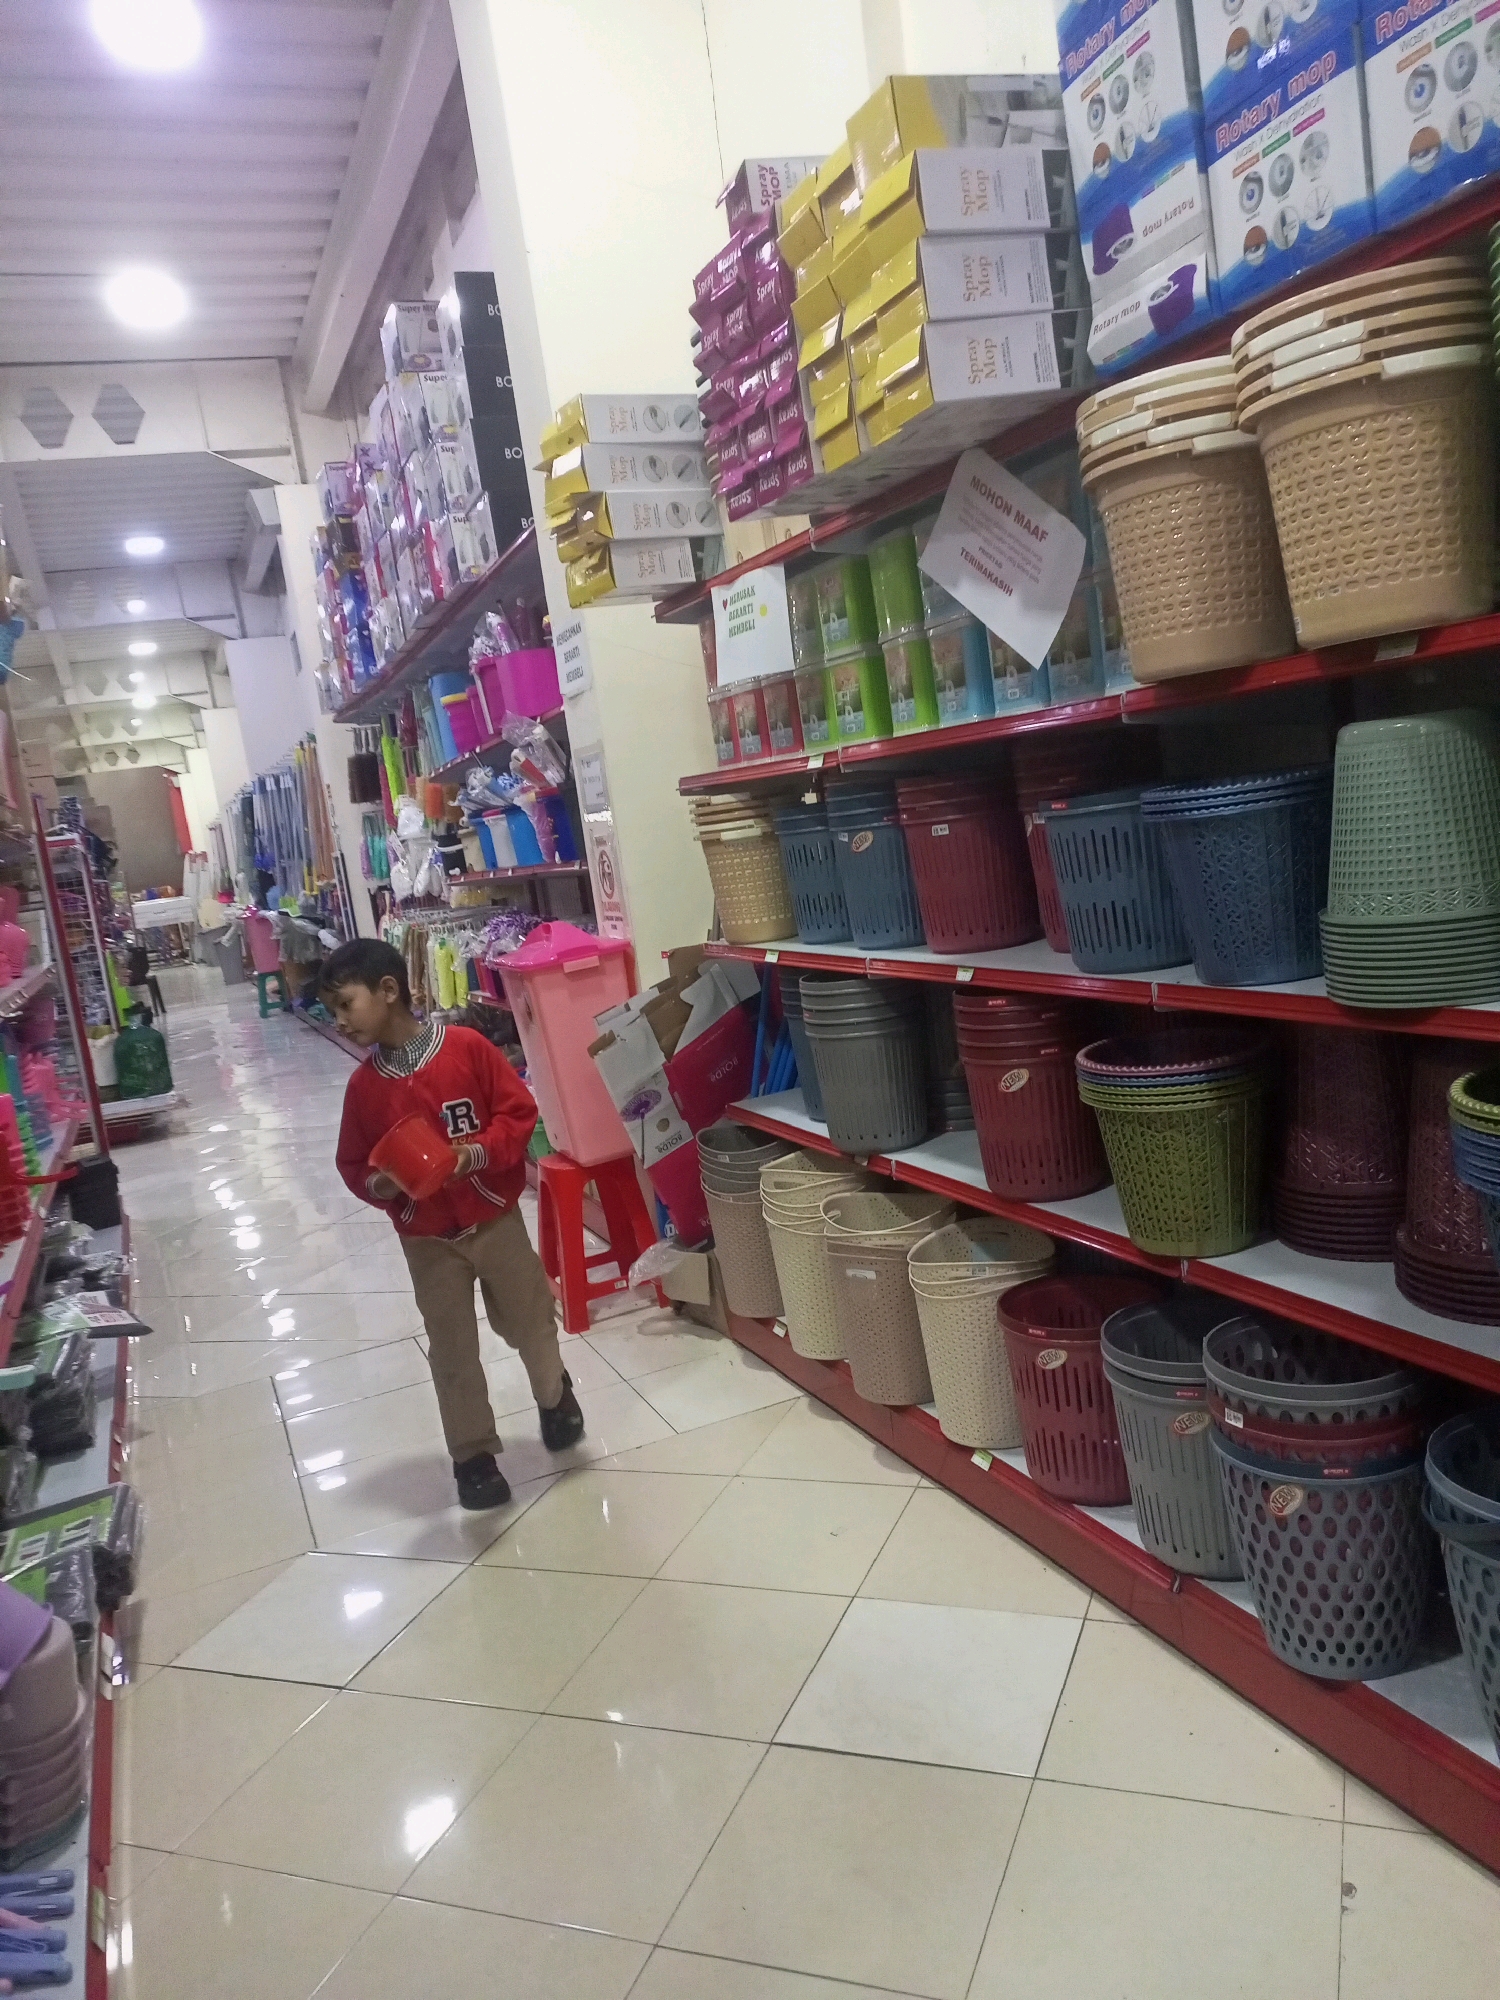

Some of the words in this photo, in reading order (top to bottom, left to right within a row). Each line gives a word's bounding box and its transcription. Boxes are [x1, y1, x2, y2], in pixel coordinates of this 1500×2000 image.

[1375, 0, 1454, 45] Rota
[1066, 16, 1116, 80] Rotary
[1216, 87, 1282, 153] Rotary
[1287, 50, 1337, 101] mop
[757, 164, 772, 207] Spray
[960, 166, 974, 217] Spray
[976, 169, 990, 214] Mop
[1164, 196, 1195, 227] Rotary
[1142, 219, 1163, 238] mop
[963, 253, 979, 302] Spray
[979, 255, 993, 298] Mop
[756, 277, 777, 305] Spray
[726, 303, 744, 328] Spray
[1093, 312, 1120, 336] Rotary
[1120, 300, 1141, 319] mop
[968, 336, 981, 386] Spray
[984, 338, 998, 379] Mop
[608, 404, 619, 434] Spray
[619, 406, 629, 433] Mop
[778, 402, 798, 425] Spray
[747, 425, 767, 446] Spray
[721, 443, 738, 463] Spray
[787, 455, 808, 477] Spray
[609, 454, 621, 484] Spray
[619, 456, 629, 482] Mop
[759, 473, 780, 493] Spray
[730, 488, 752, 510] Spray
[969, 474, 1013, 517] MOHON
[1013, 509, 1049, 543] MAAF
[633, 502, 643, 531] Spray
[643, 503, 652, 529] Mop
[959, 546, 1014, 597] TERIMAKASIH
[728, 585, 756, 607] MERUSAK
[728, 603, 754, 622] BERARTI
[728, 618, 756, 639] MEMBELI
[1001, 1070, 1024, 1091] NEW
[442, 1098, 481, 1138] R
[1039, 1349, 1060, 1365] NEW
[1175, 1412, 1204, 1432] NEW
[1271, 1485, 1297, 1512] NEW
